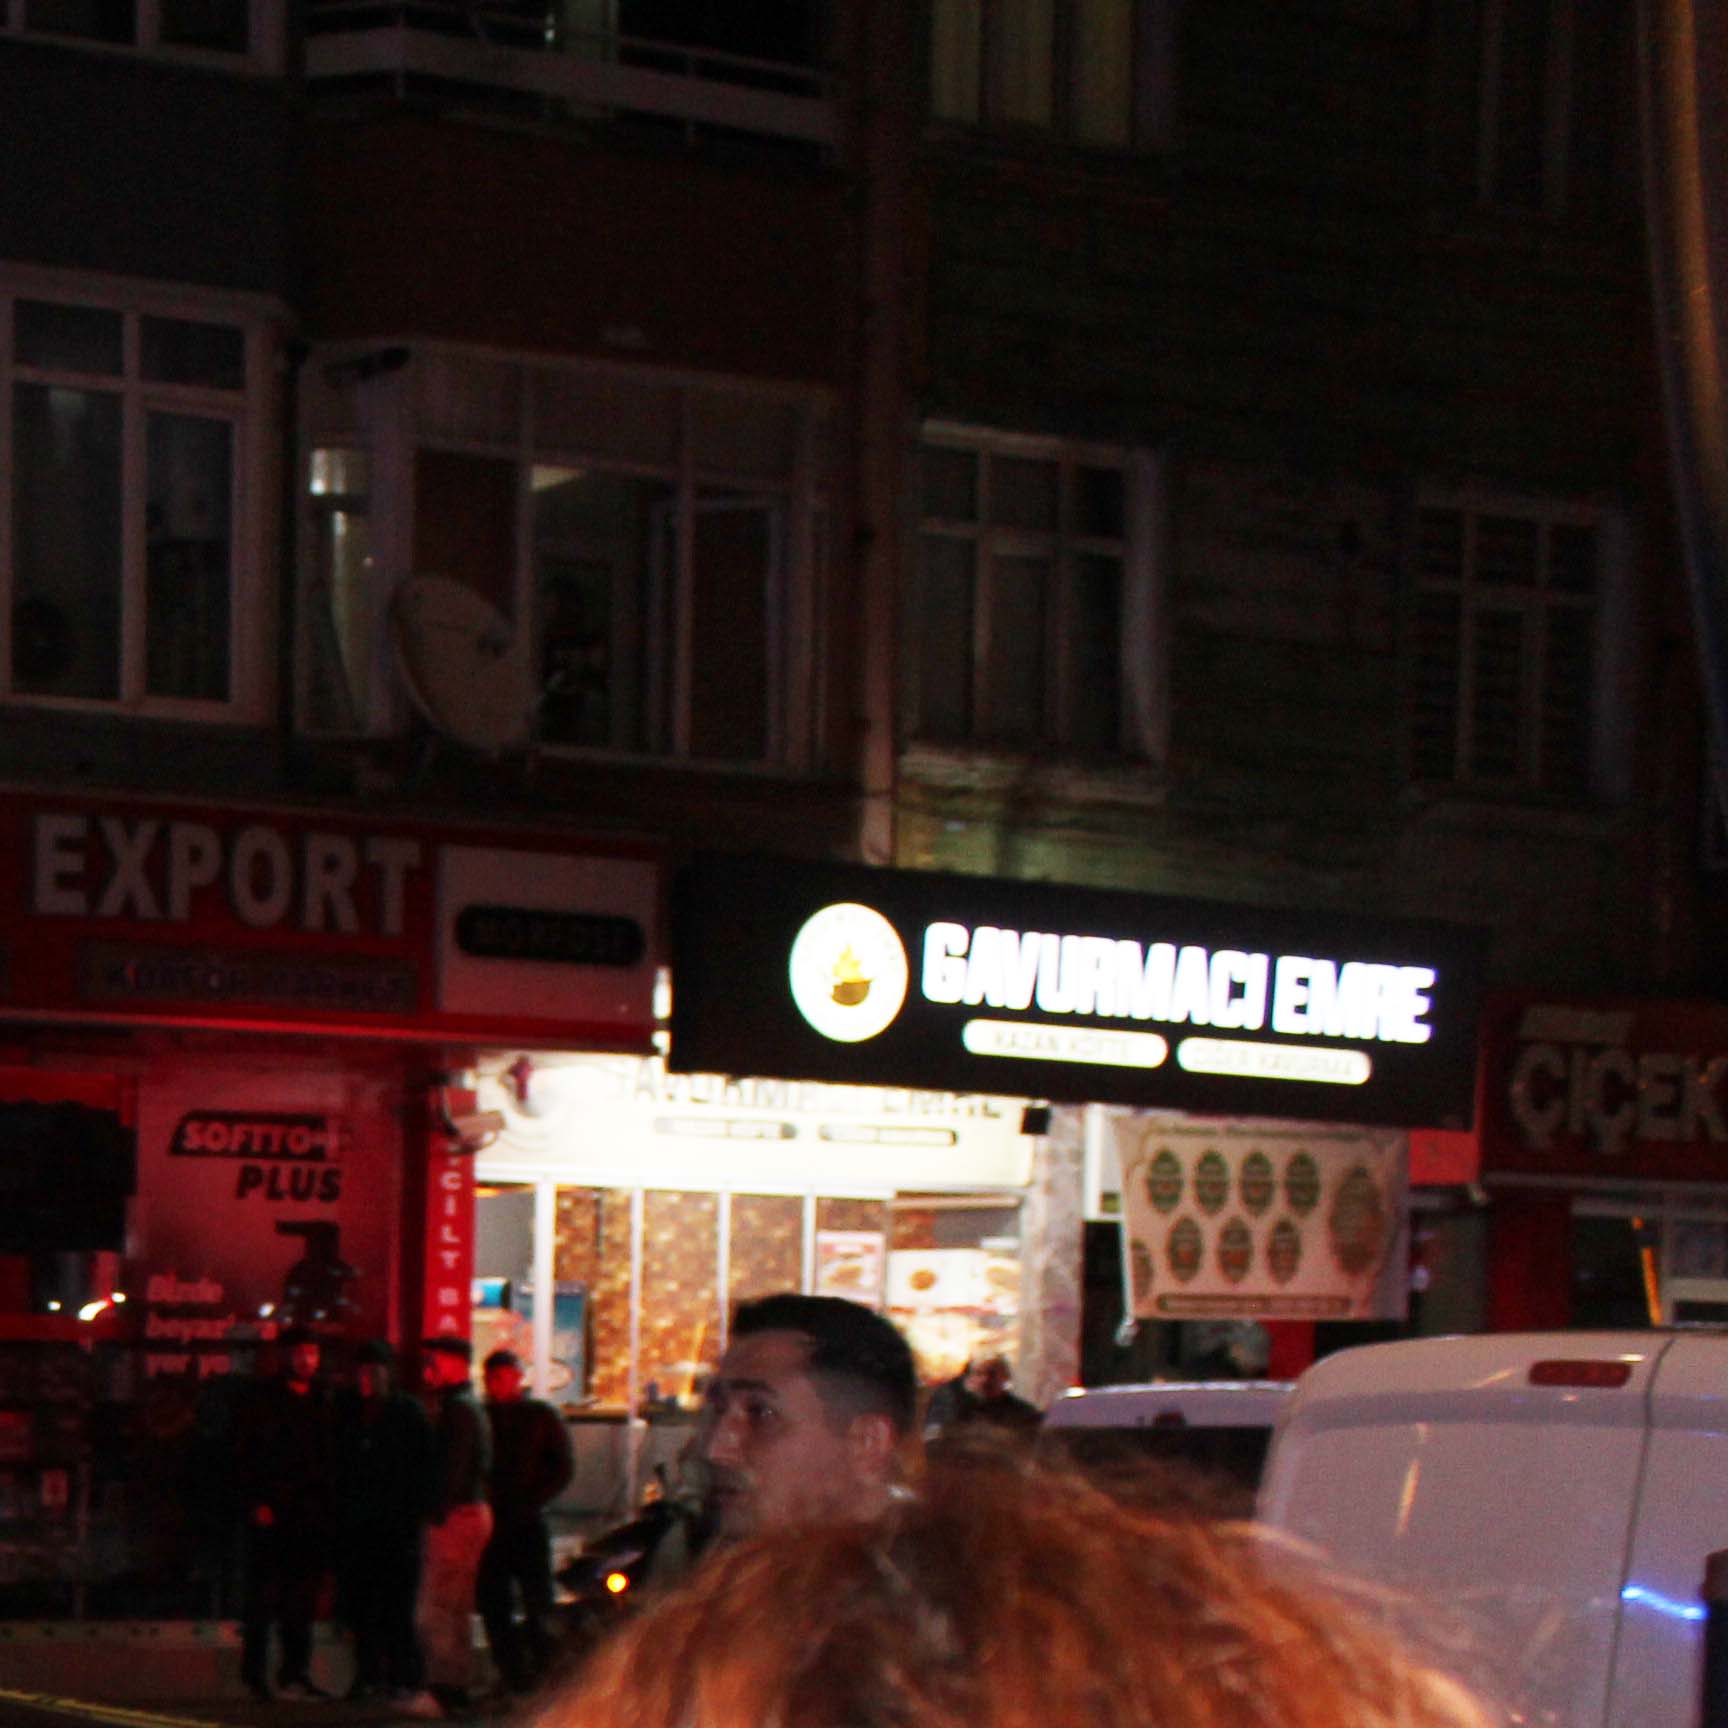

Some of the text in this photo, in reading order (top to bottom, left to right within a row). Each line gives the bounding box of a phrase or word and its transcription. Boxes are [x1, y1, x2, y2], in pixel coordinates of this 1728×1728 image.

[30, 811, 422, 939] EXPORT
[921, 922, 1269, 1030] GAVURMACI
[1272, 955, 1436, 1044] EMRE
[235, 1164, 343, 1203] PLUS
